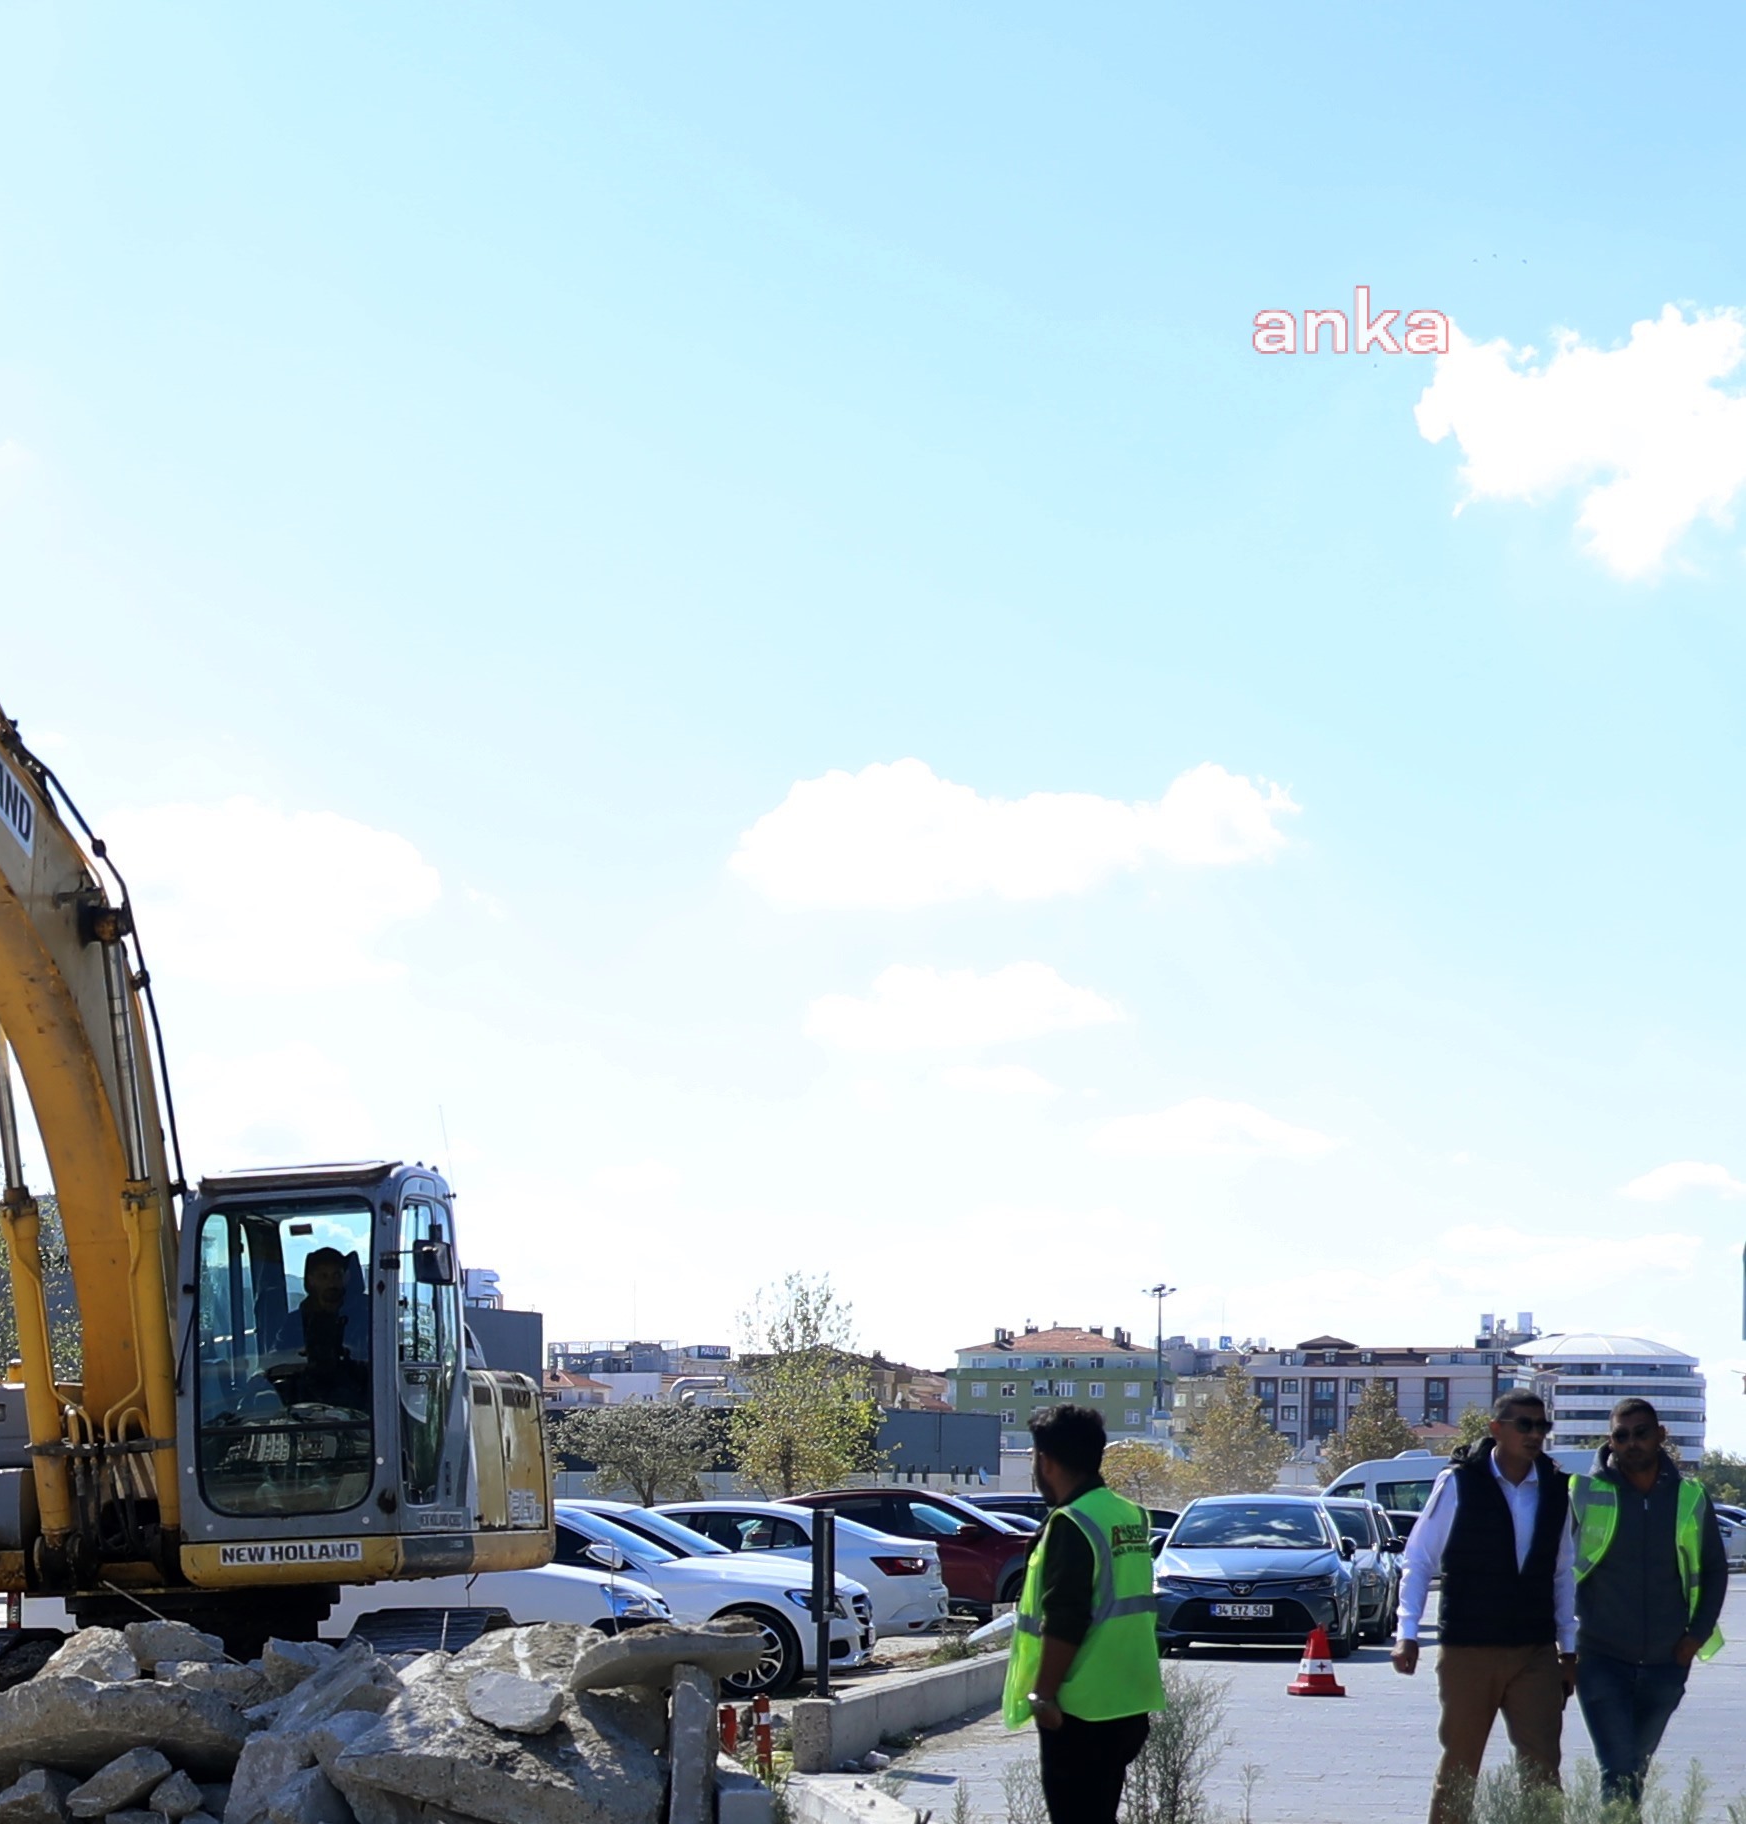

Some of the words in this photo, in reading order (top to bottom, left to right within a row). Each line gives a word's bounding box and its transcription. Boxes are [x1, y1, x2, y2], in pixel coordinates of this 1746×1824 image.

[221, 1546, 266, 1563] NEW
[270, 1542, 360, 1562] HOLLAND
[1217, 1604, 1229, 1616] 34
